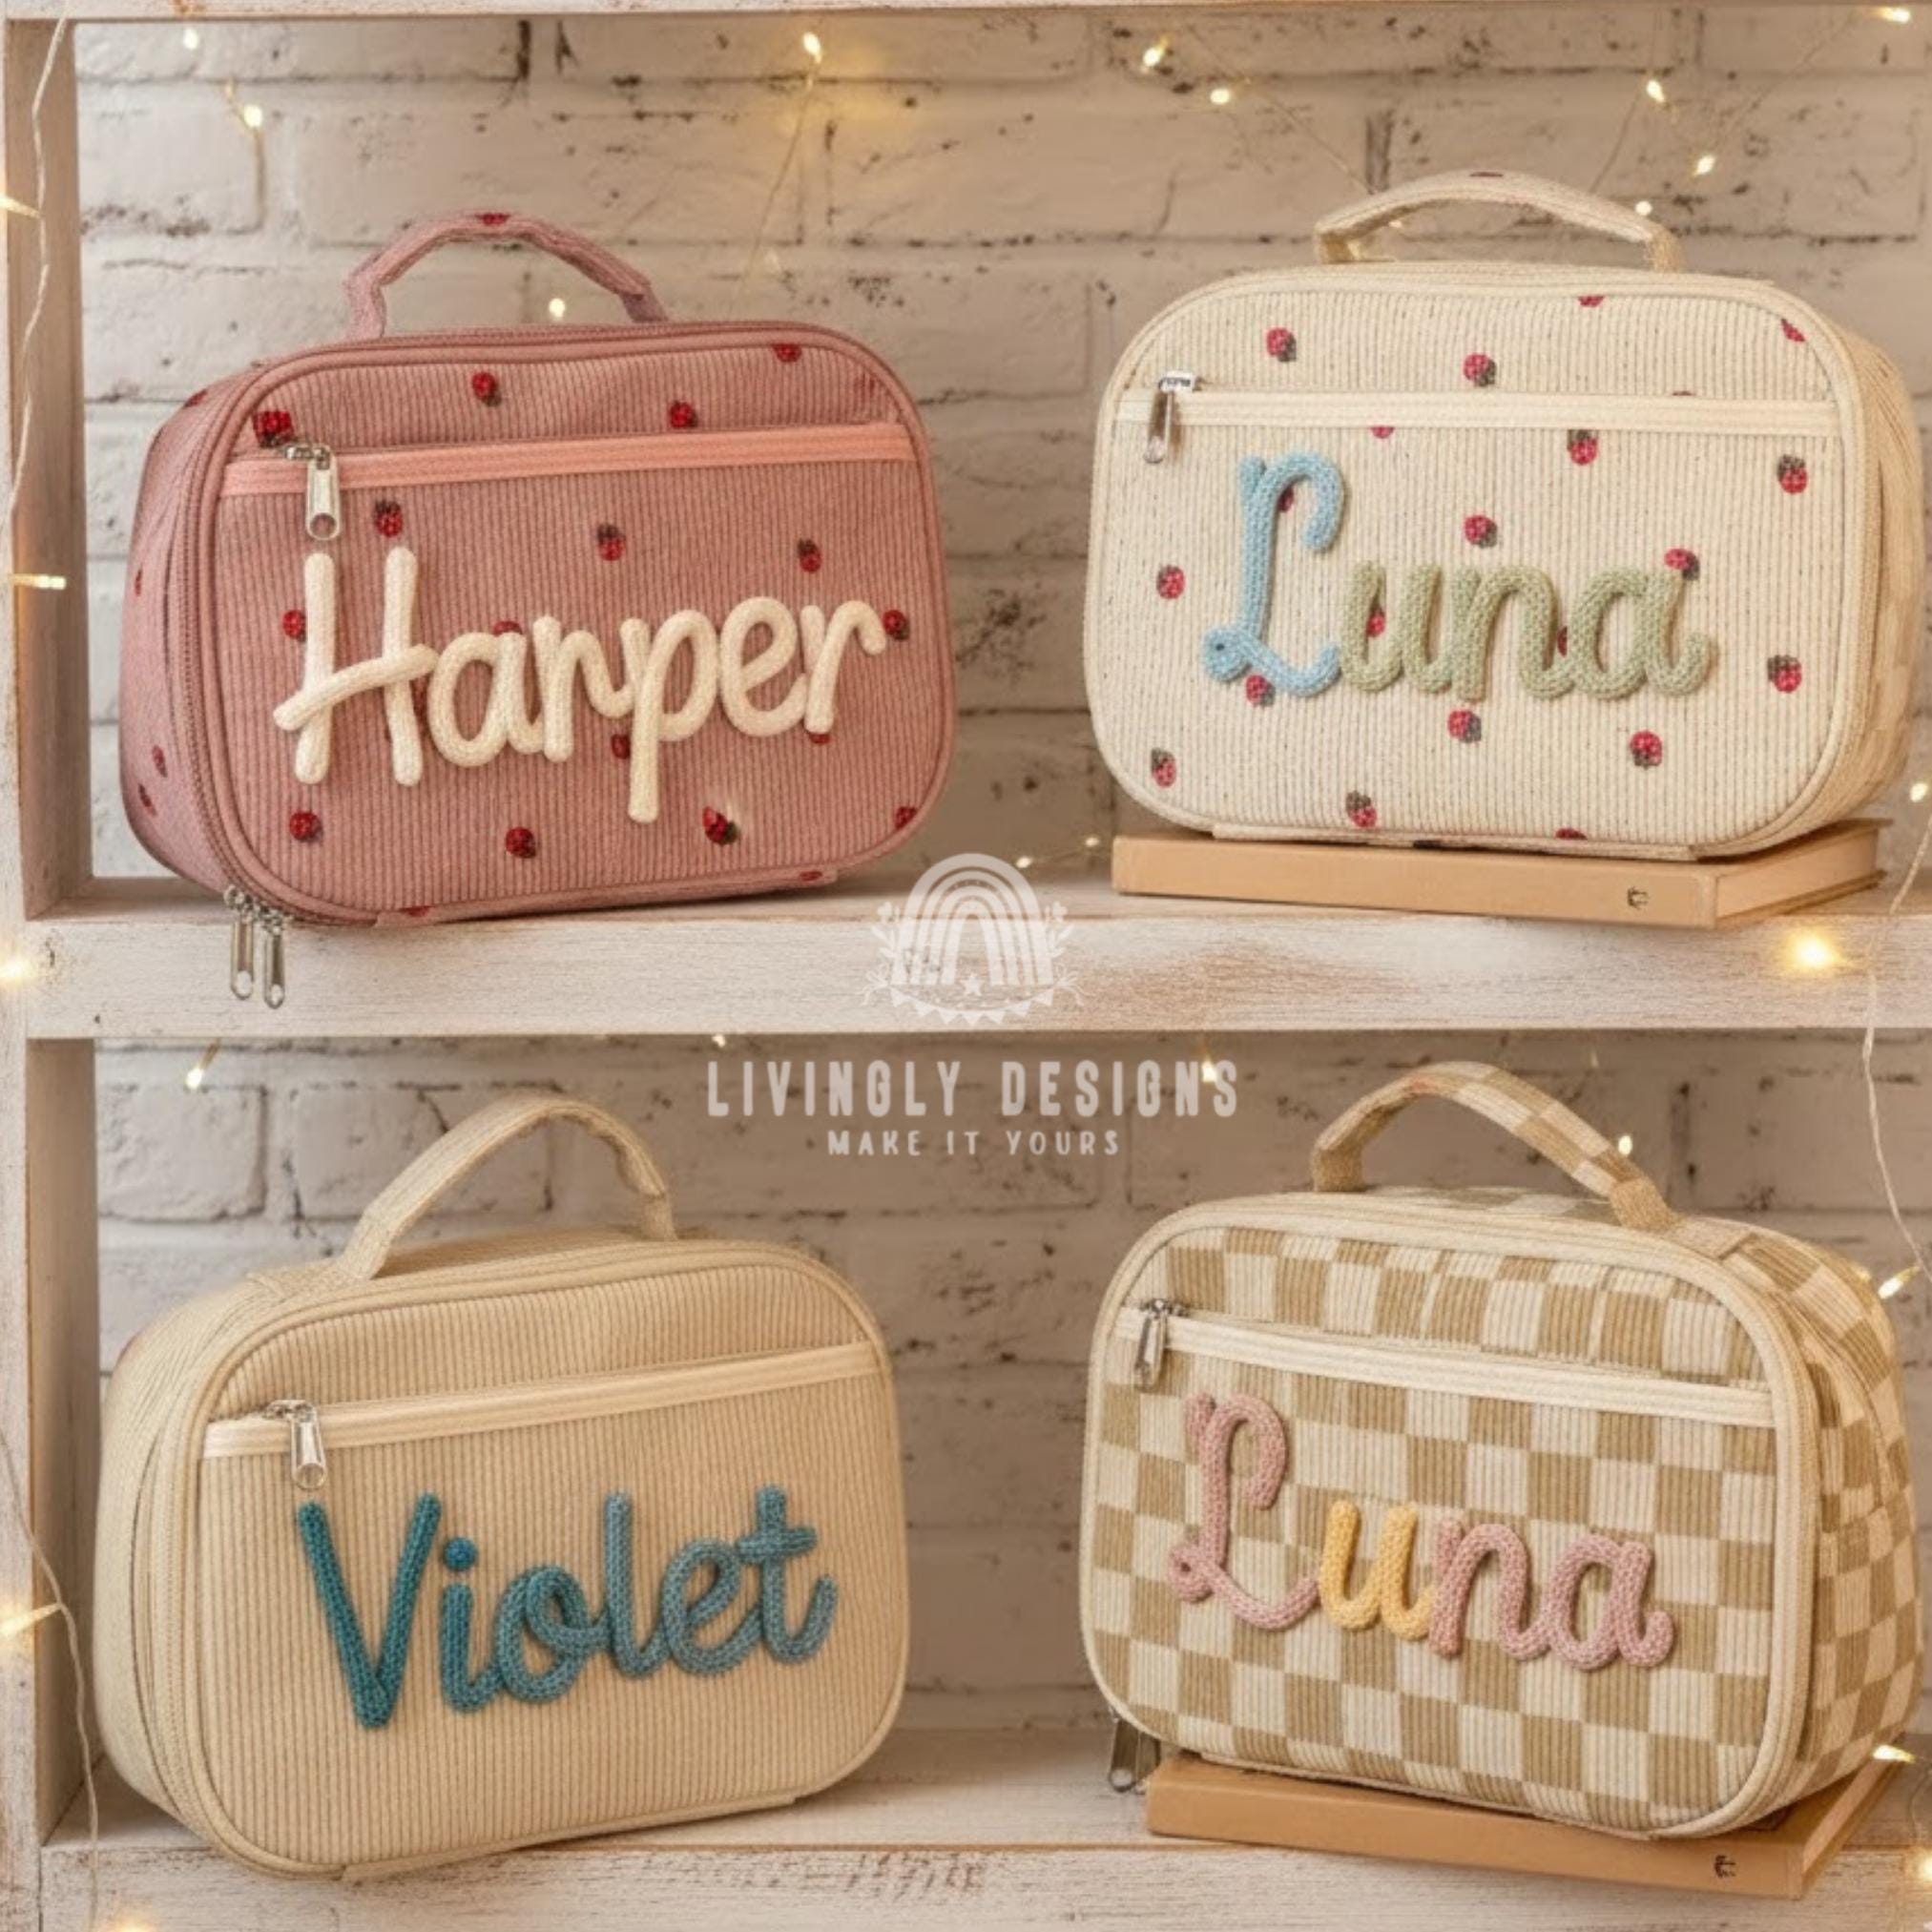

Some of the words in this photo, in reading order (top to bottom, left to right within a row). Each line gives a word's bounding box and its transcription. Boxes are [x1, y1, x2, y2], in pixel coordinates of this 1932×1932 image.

[273, 547, 885, 823] Harper
[1202, 452, 1714, 700] Luna
[298, 1485, 838, 1729] Violet
[1169, 1393, 1674, 1671] Luna
